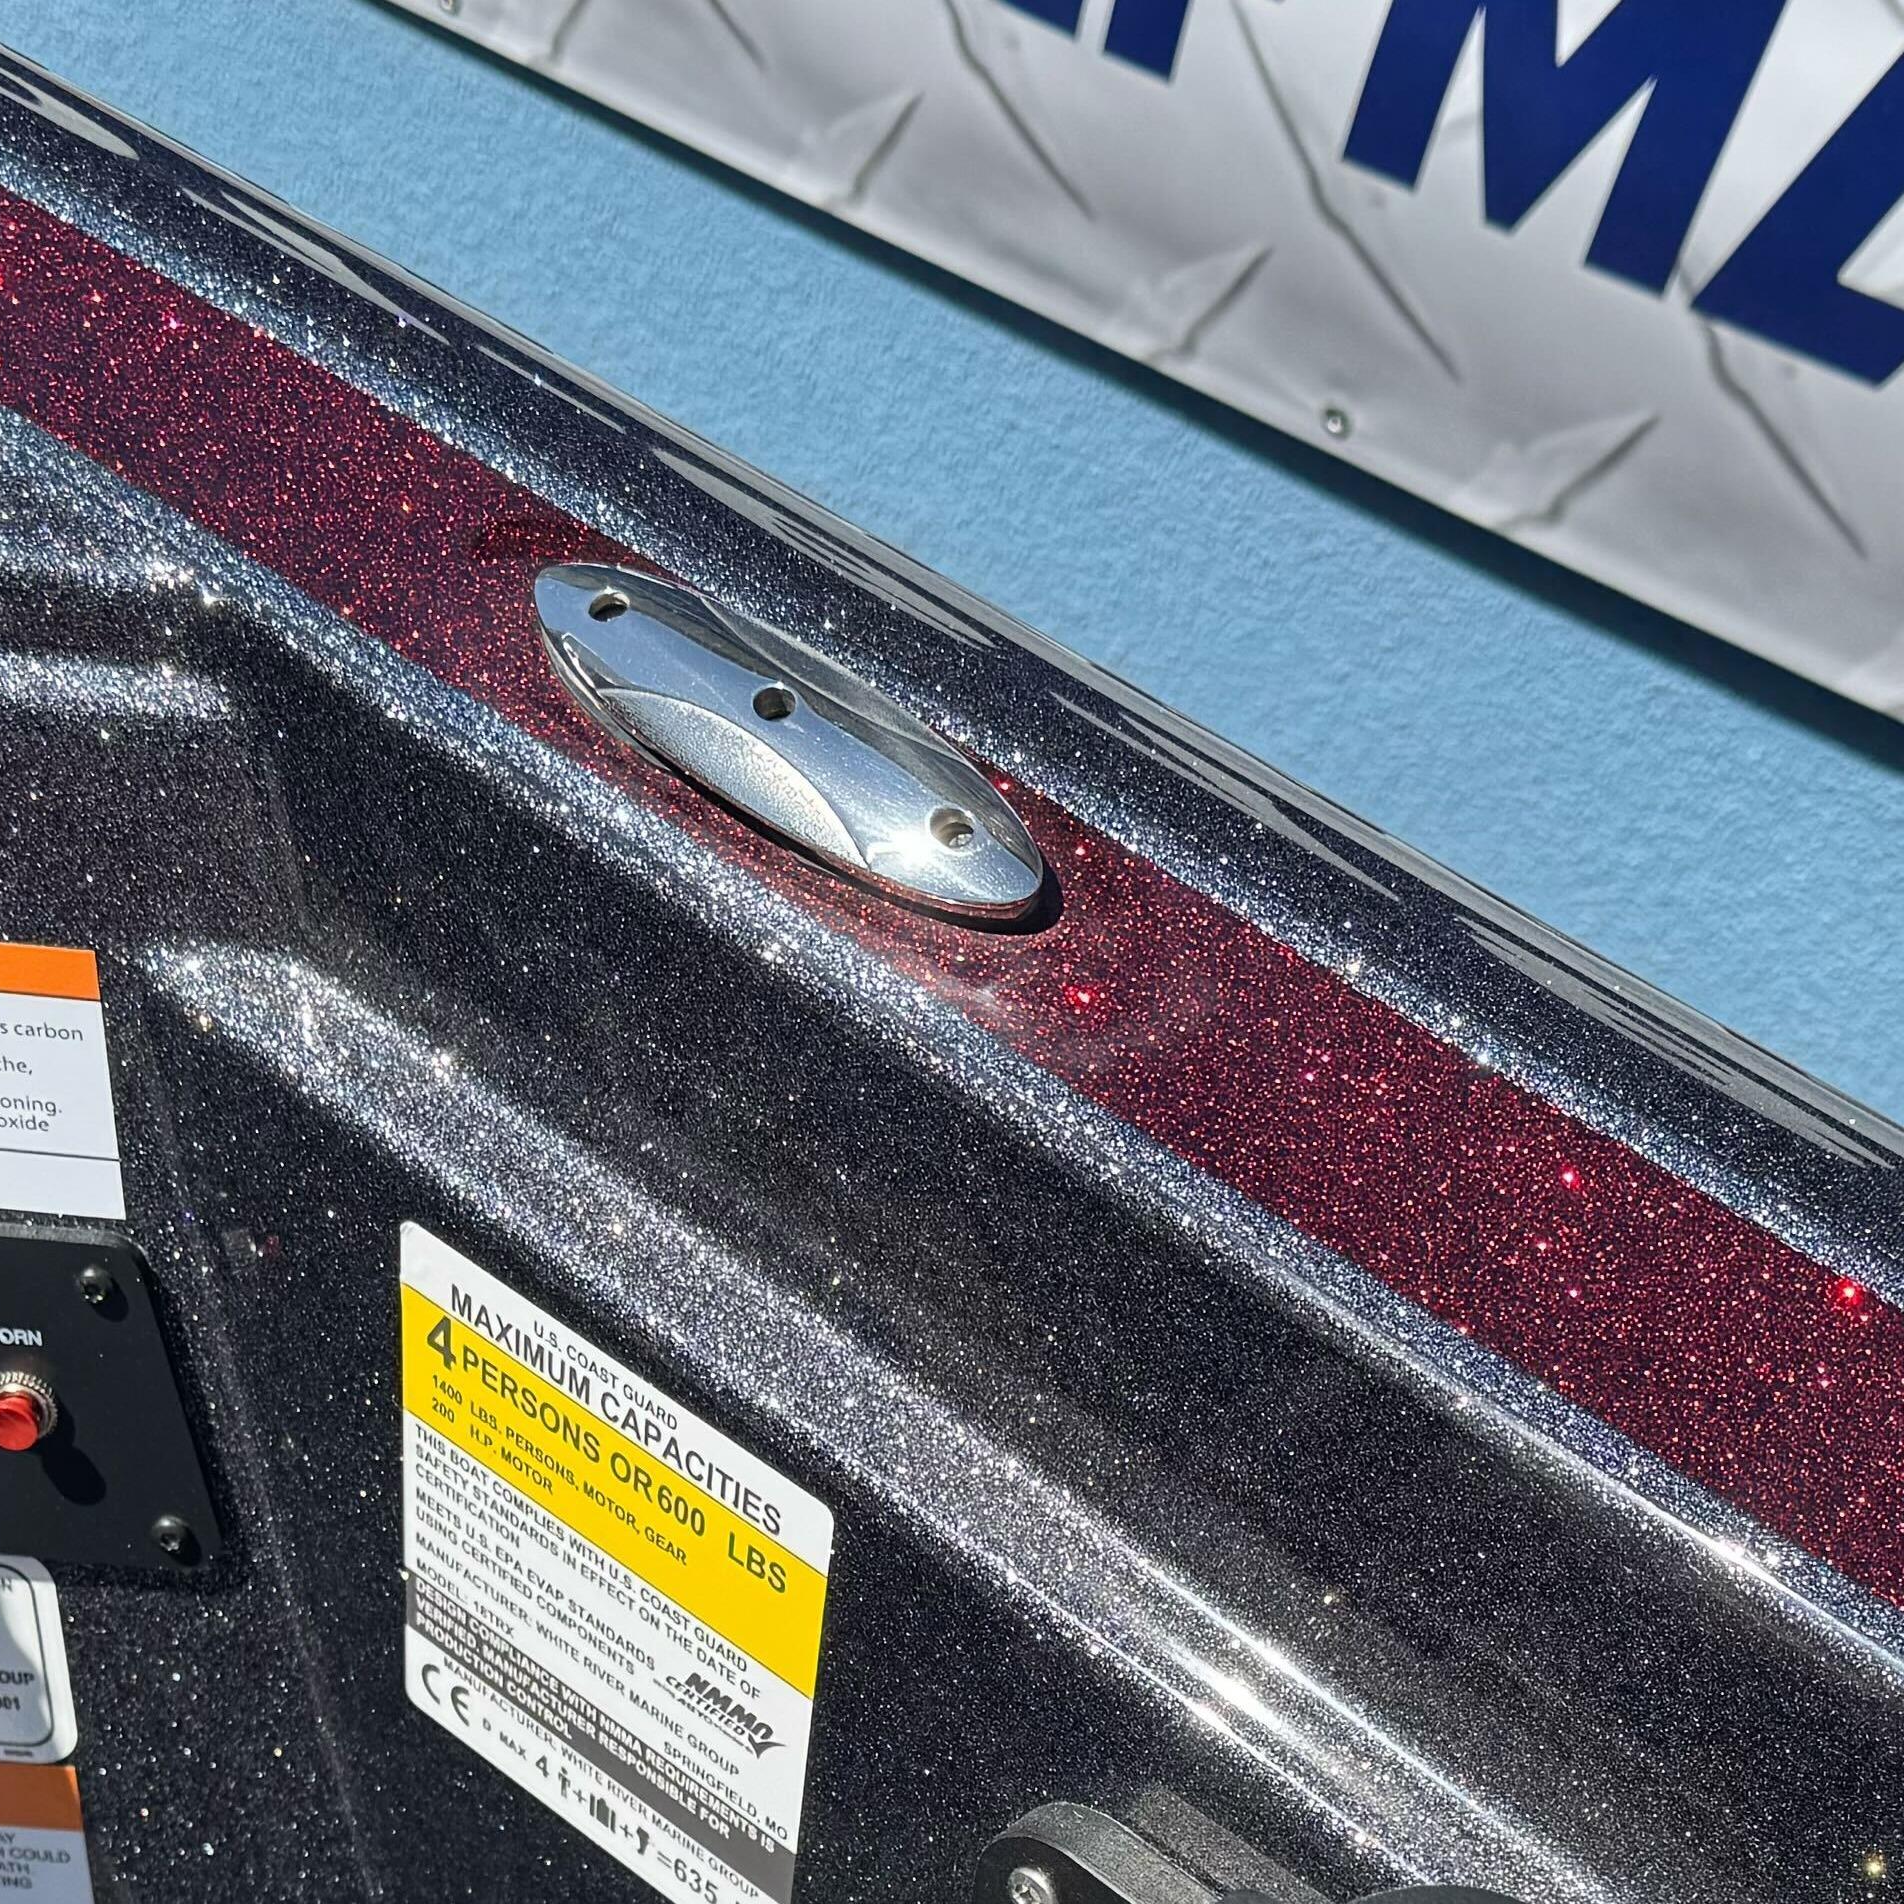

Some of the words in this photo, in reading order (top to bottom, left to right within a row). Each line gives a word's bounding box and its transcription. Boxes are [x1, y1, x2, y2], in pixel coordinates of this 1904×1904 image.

[12, 1020, 83, 1039] carbon
[427, 1314, 457, 1371] 4
[462, 1343, 600, 1466] PERSONS
[609, 1447, 654, 1503] OR
[656, 1480, 706, 1539] 600
[727, 1530, 787, 1596] LBS
[431, 1395, 455, 1425] 200
[500, 1444, 553, 1495] MOTOR
[451, 1283, 590, 1406] MAXIMUM
[600, 1387, 781, 1538] CAPACITIES
[566, 1342, 618, 1392] COAST
[623, 1381, 677, 1433] GUARD
[415, 1461, 519, 1550] CERTIFICATION
[415, 1423, 445, 1458] THIS
[450, 1448, 488, 1488] BOAT
[492, 1479, 564, 1543] COMPLIES
[569, 1534, 604, 1572] WITH
[640, 1585, 690, 1633] COAST
[693, 1624, 748, 1675] GUARD
[432, 1373, 463, 1408] 1400
[643, 1523, 687, 1567] GEAR
[415, 1443, 468, 1494] SAFETY
[472, 1484, 558, 1559] STANDARDS
[562, 1549, 576, 1572] IN
[580, 1562, 635, 1614] EFFECT
[638, 1603, 660, 1632] ON
[664, 1622, 693, 1655] THE
[696, 1645, 736, 1686] DATE
[739, 1676, 760, 1704] OF
[416, 1486, 461, 1532] MEETS
[495, 1544, 523, 1577] EPA
[526, 1567, 564, 1607] EVAP
[568, 1597, 655, 1672] STANDARDS
[416, 1506, 457, 1548] USING
[461, 1539, 532, 1603] CERTIFIED
[536, 1593, 634, 1677] COMPONENTS
[473, 1598, 514, 1640] 18TRX
[499, 1729, 526, 1761] MAX
[535, 1749, 549, 1780] 4
[535, 1619, 579, 1663] WHITE
[583, 1654, 625, 1696] RIVER
[629, 1687, 684, 1740] MARINE
[686, 1730, 739, 1781] GROUP
[764, 1815, 788, 1843] MO
